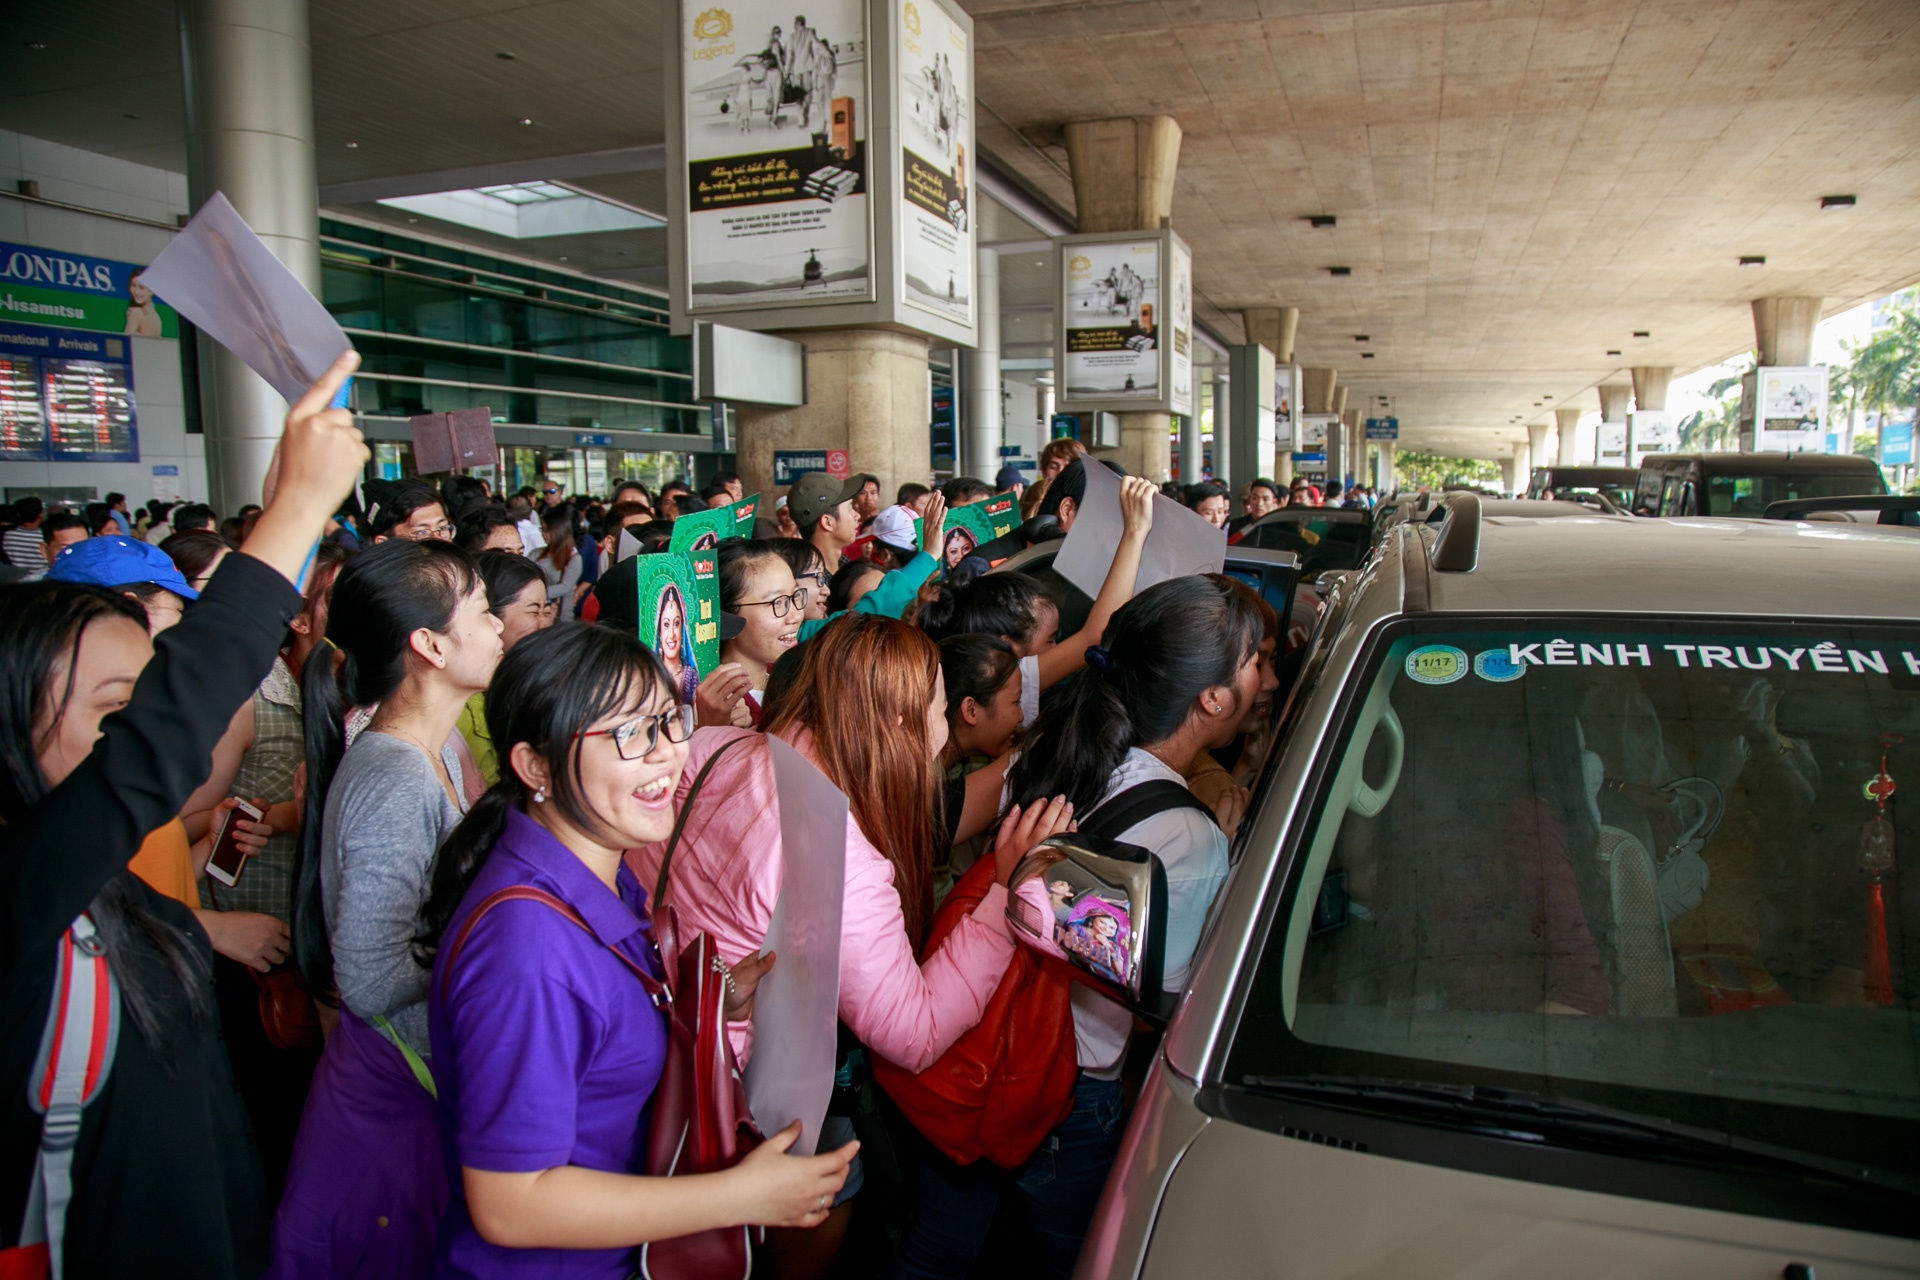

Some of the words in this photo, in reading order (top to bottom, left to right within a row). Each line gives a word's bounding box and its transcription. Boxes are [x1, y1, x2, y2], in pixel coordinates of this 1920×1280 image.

[58, 337, 99, 352] Arrivals
[1414, 657, 1451, 668] 11/17
[1483, 658, 1509, 667] 11/1
[1508, 638, 1651, 666] KÊNH
[1663, 641, 1889, 674] TRUYỀN
